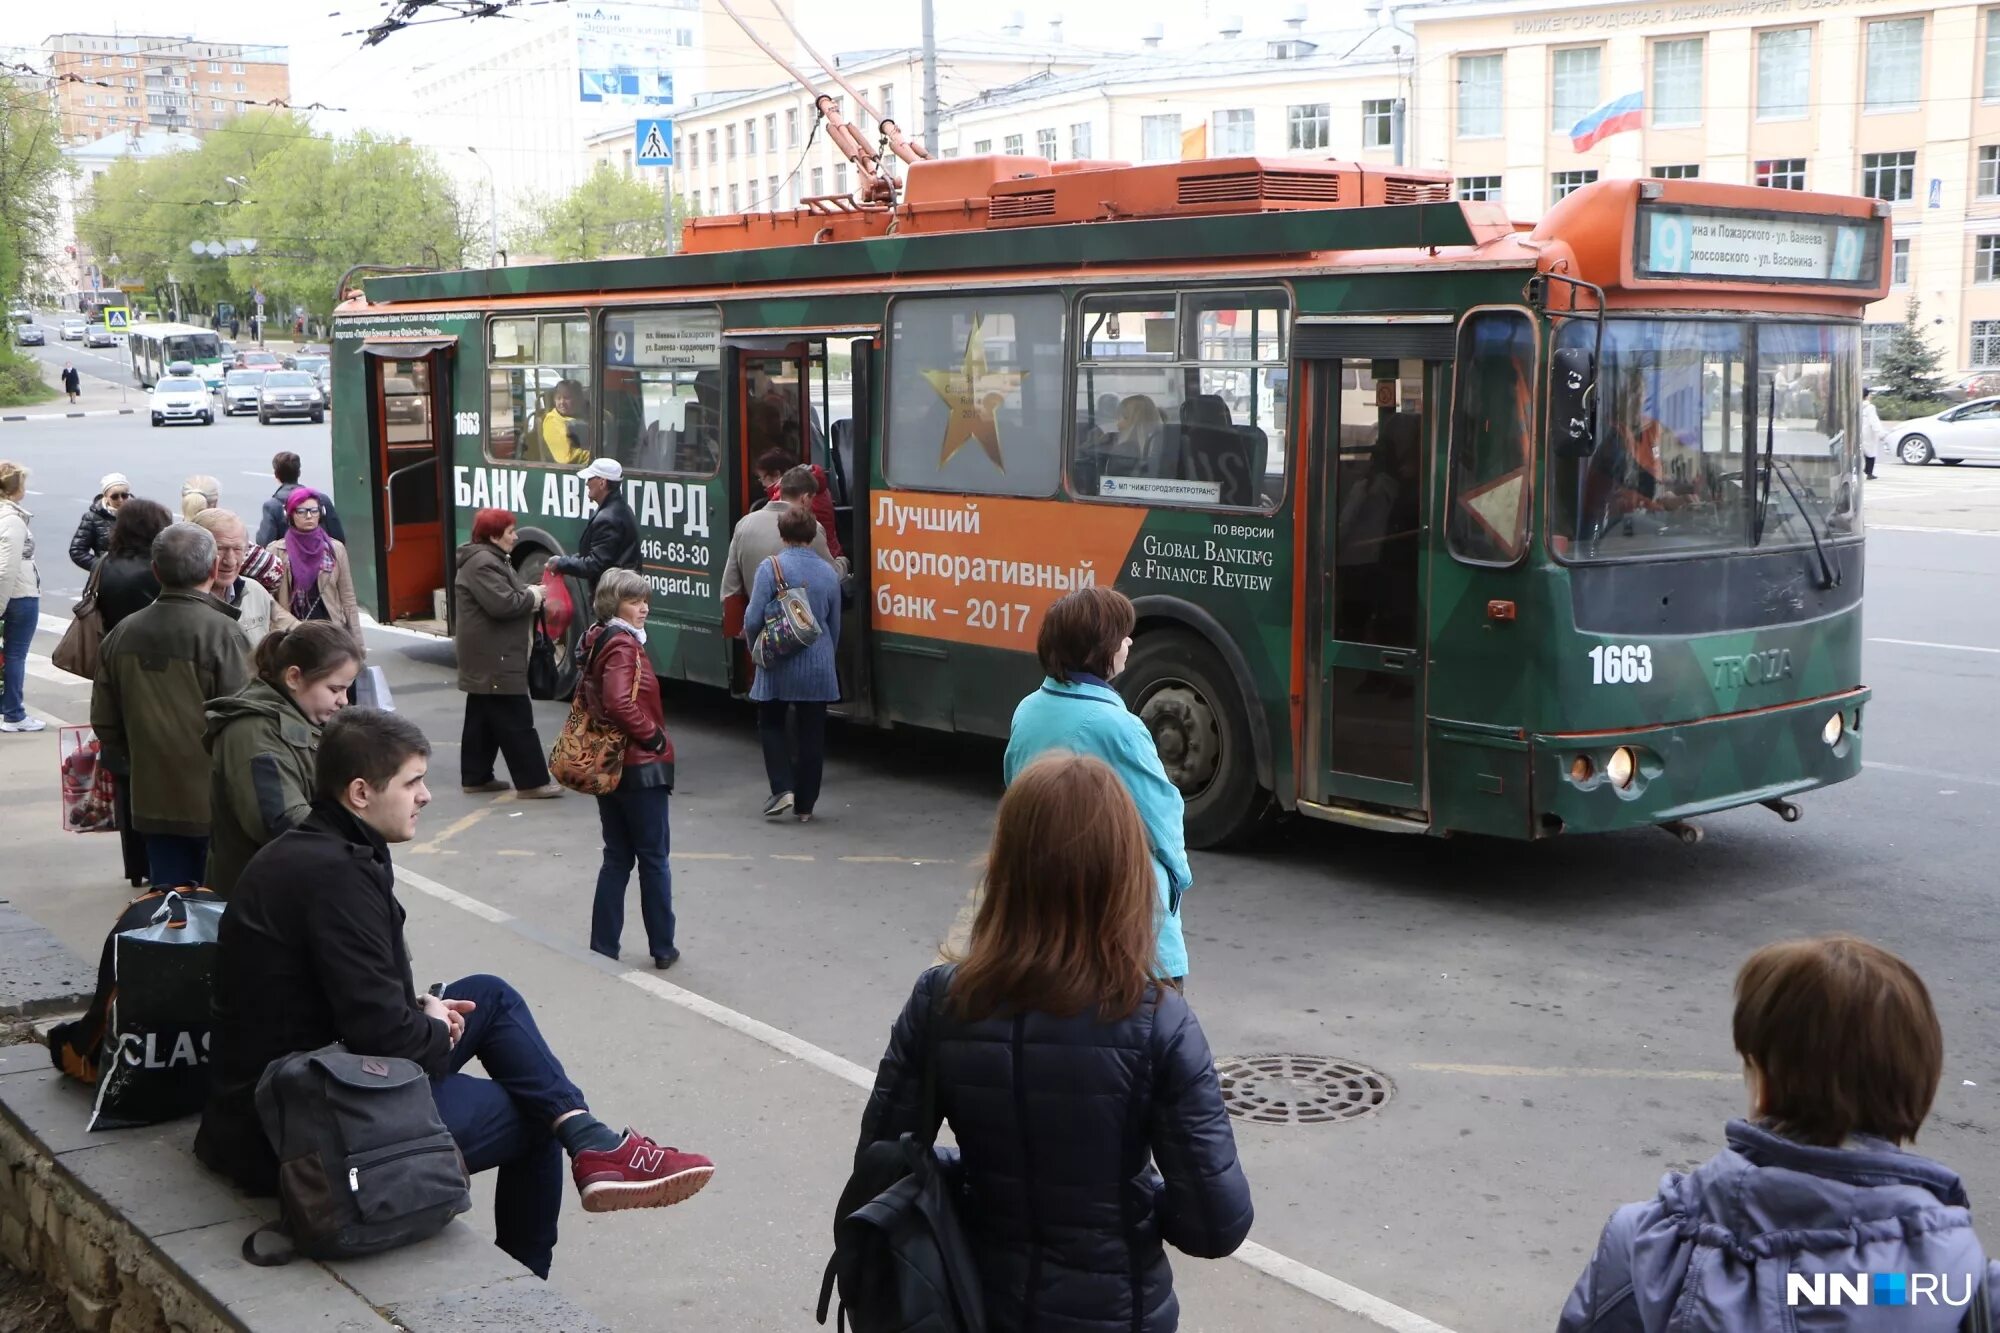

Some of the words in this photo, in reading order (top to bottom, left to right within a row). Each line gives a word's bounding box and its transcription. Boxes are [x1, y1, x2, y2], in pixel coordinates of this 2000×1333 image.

[1513, 9, 1664, 34] НИЖЕГОРОДСКАЯ
[1659, 217, 1683, 272] 9
[1711, 228, 1716, 237] и
[1718, 224, 1770, 242] Пожарского
[1776, 233, 1788, 245] ул.
[1790, 232, 1822, 245] Ванеева
[1759, 254, 1771, 267] ул.
[1773, 253, 1812, 268] Васюнина
[1839, 230, 1858, 277] 9
[401, 314, 418, 322] России
[426, 313, 444, 322] версии
[445, 312, 480, 322] финансового
[614, 331, 626, 361] 9
[654, 344, 675, 352] Ванеева
[679, 344, 716, 353] кардиоцентр
[454, 411, 480, 435] 1663
[1118, 483, 1128, 491] МП
[454, 465, 528, 514] БАНК
[541, 472, 710, 538] АВАГАРД
[875, 497, 980, 535] Лучший
[1213, 524, 1228, 535] по
[1230, 525, 1274, 540] версии
[640, 539, 710, 566] 416-63-30
[876, 548, 1095, 592] корпоративный
[1131, 561, 1142, 578] &
[641, 573, 710, 598] angard.ru
[876, 584, 936, 621] банк
[966, 598, 1031, 633] 2017
[1588, 644, 1653, 685] 1663
[629, 1145, 664, 1173] N
